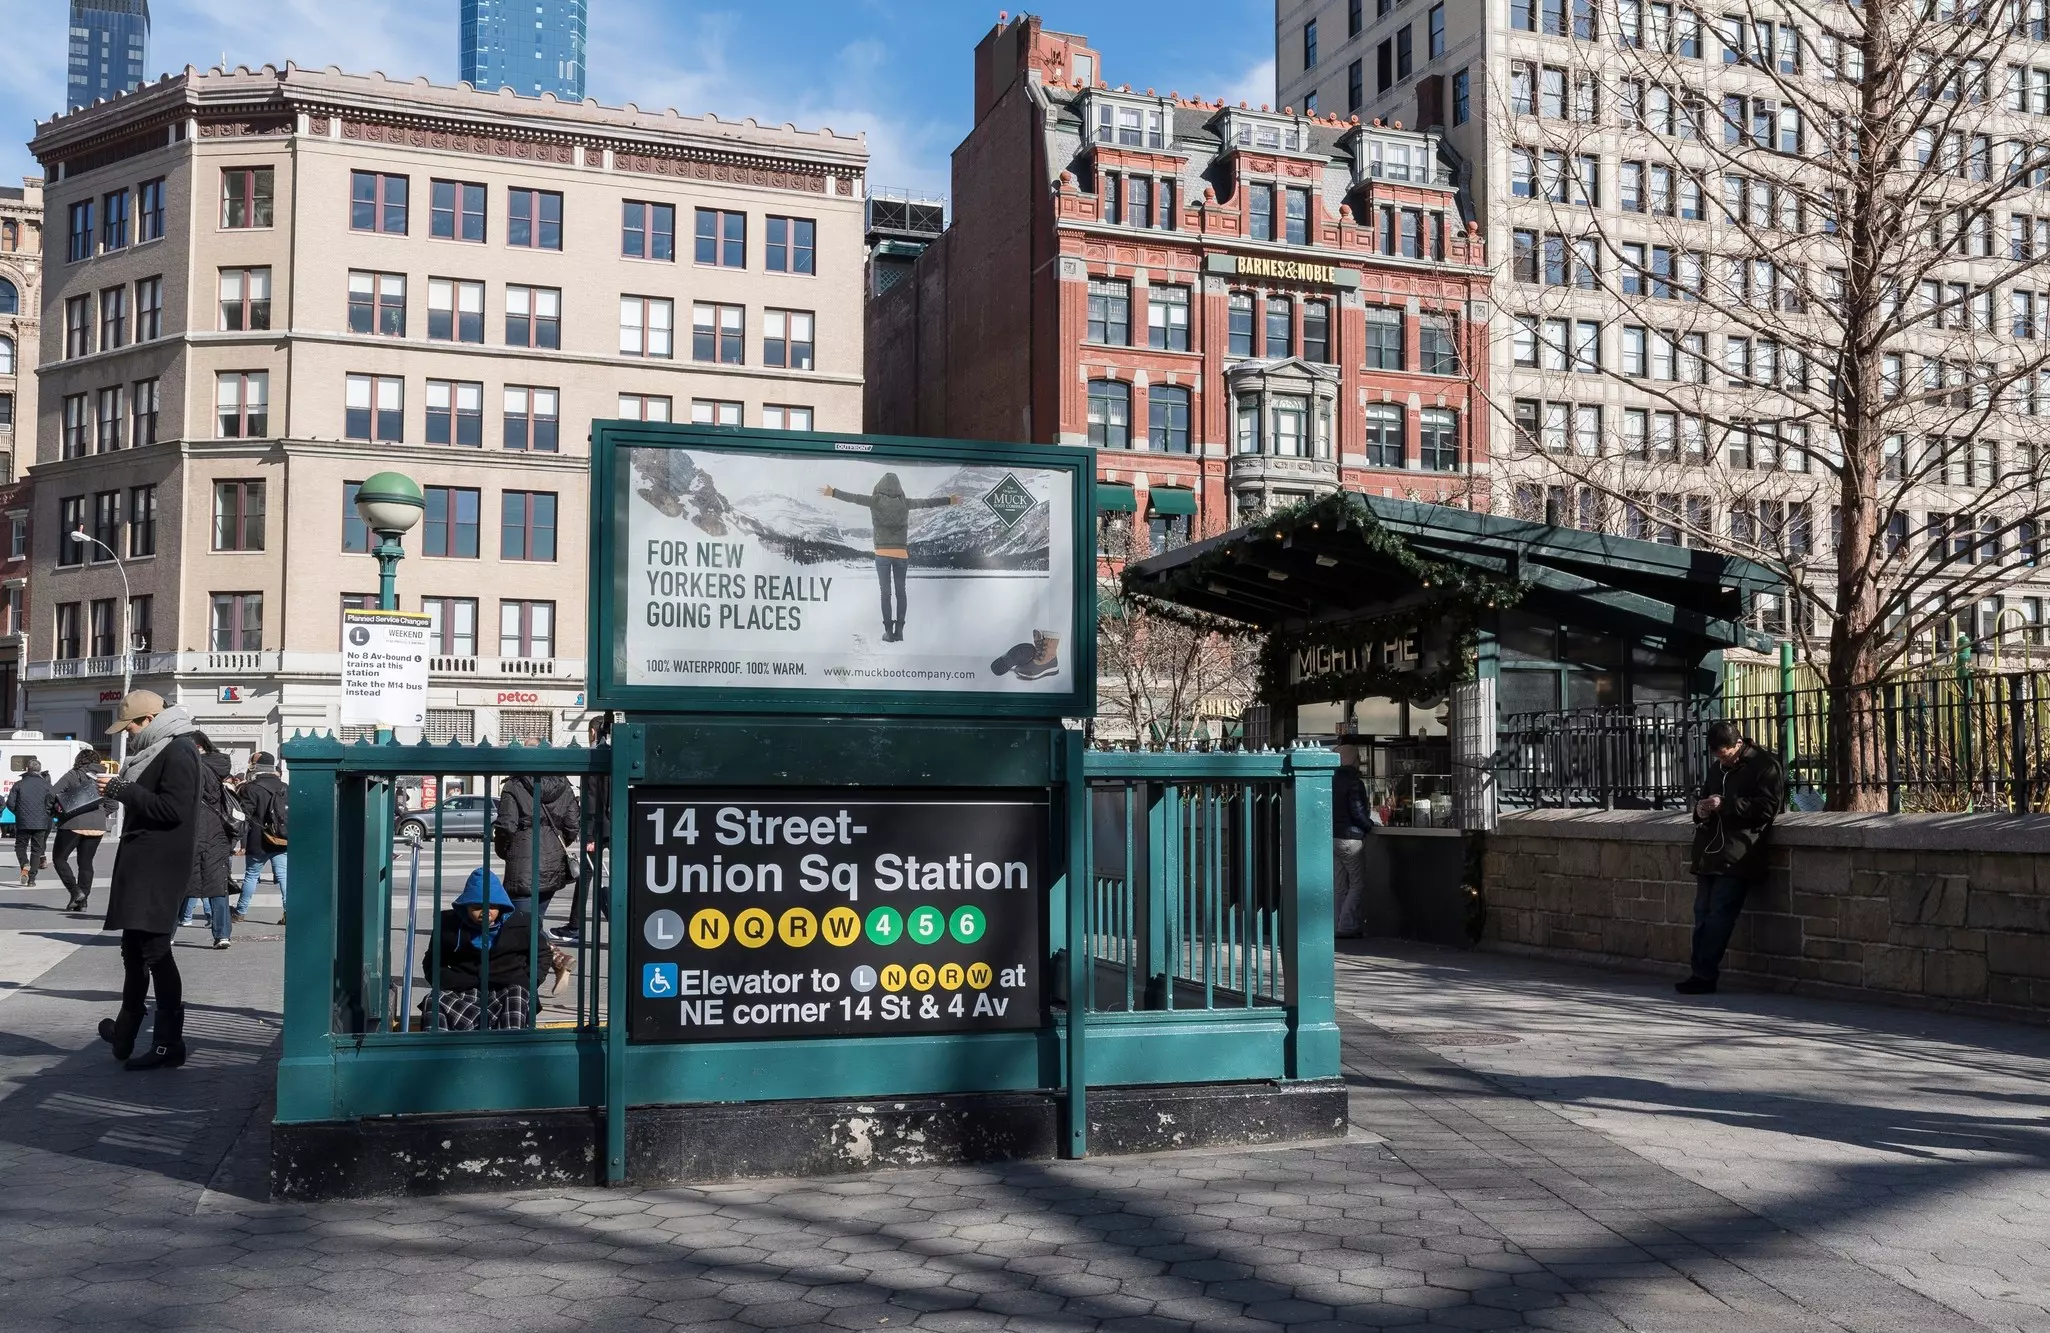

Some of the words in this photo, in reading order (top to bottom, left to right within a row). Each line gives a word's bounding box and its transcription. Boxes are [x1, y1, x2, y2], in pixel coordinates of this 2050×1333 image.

[993, 493, 1027, 505] MUCK
[647, 539, 688, 566] FOR
[696, 542, 744, 568] NEW
[646, 570, 746, 599] YORKERS
[754, 574, 832, 602] REALLY
[347, 614, 375, 623] Planned
[375, 615, 399, 624] Service
[399, 618, 429, 627] Changes
[646, 601, 711, 628] GOING
[719, 603, 801, 631] PLACES
[388, 629, 423, 639] WEEKEND
[1383, 627, 1419, 664] PIE
[370, 653, 412, 662] Av-bound
[346, 660, 375, 668] trains
[388, 662, 404, 670] this
[646, 659, 670, 673] 100%
[672, 660, 742, 674] WATERPROOF.
[746, 661, 770, 674] 100%
[772, 662, 807, 676] WARM.
[346, 669, 380, 677] station
[823, 667, 976, 681] www.muckbootcompany.com
[345, 688, 381, 697] instead
[346, 680, 368, 688] Take
[387, 681, 404, 689] M14
[406, 683, 423, 691] bus
[100, 690, 122, 703] petco
[497, 691, 538, 704] petco
[646, 808, 700, 845] 14
[715, 807, 868, 846] Street-
[646, 855, 783, 894] Union
[799, 854, 858, 900] Sq
[874, 853, 1028, 892] Station
[657, 918, 674, 940] L
[700, 918, 718, 939] N
[743, 917, 765, 939] Q
[789, 917, 808, 938] R
[828, 917, 854, 938] W
[876, 914, 892, 936] 4
[919, 915, 934, 936] 5
[960, 914, 975, 935] 6
[681, 969, 803, 995] Elevator
[811, 969, 840, 993] to
[1000, 964, 1026, 988] at
[681, 1000, 724, 1026] NE
[733, 1002, 831, 1025] corner
[839, 996, 873, 1022] 14
[881, 995, 911, 1021] St
[918, 994, 940, 1020] &
[948, 994, 965, 1018] 4
[972, 992, 1009, 1018] Av
